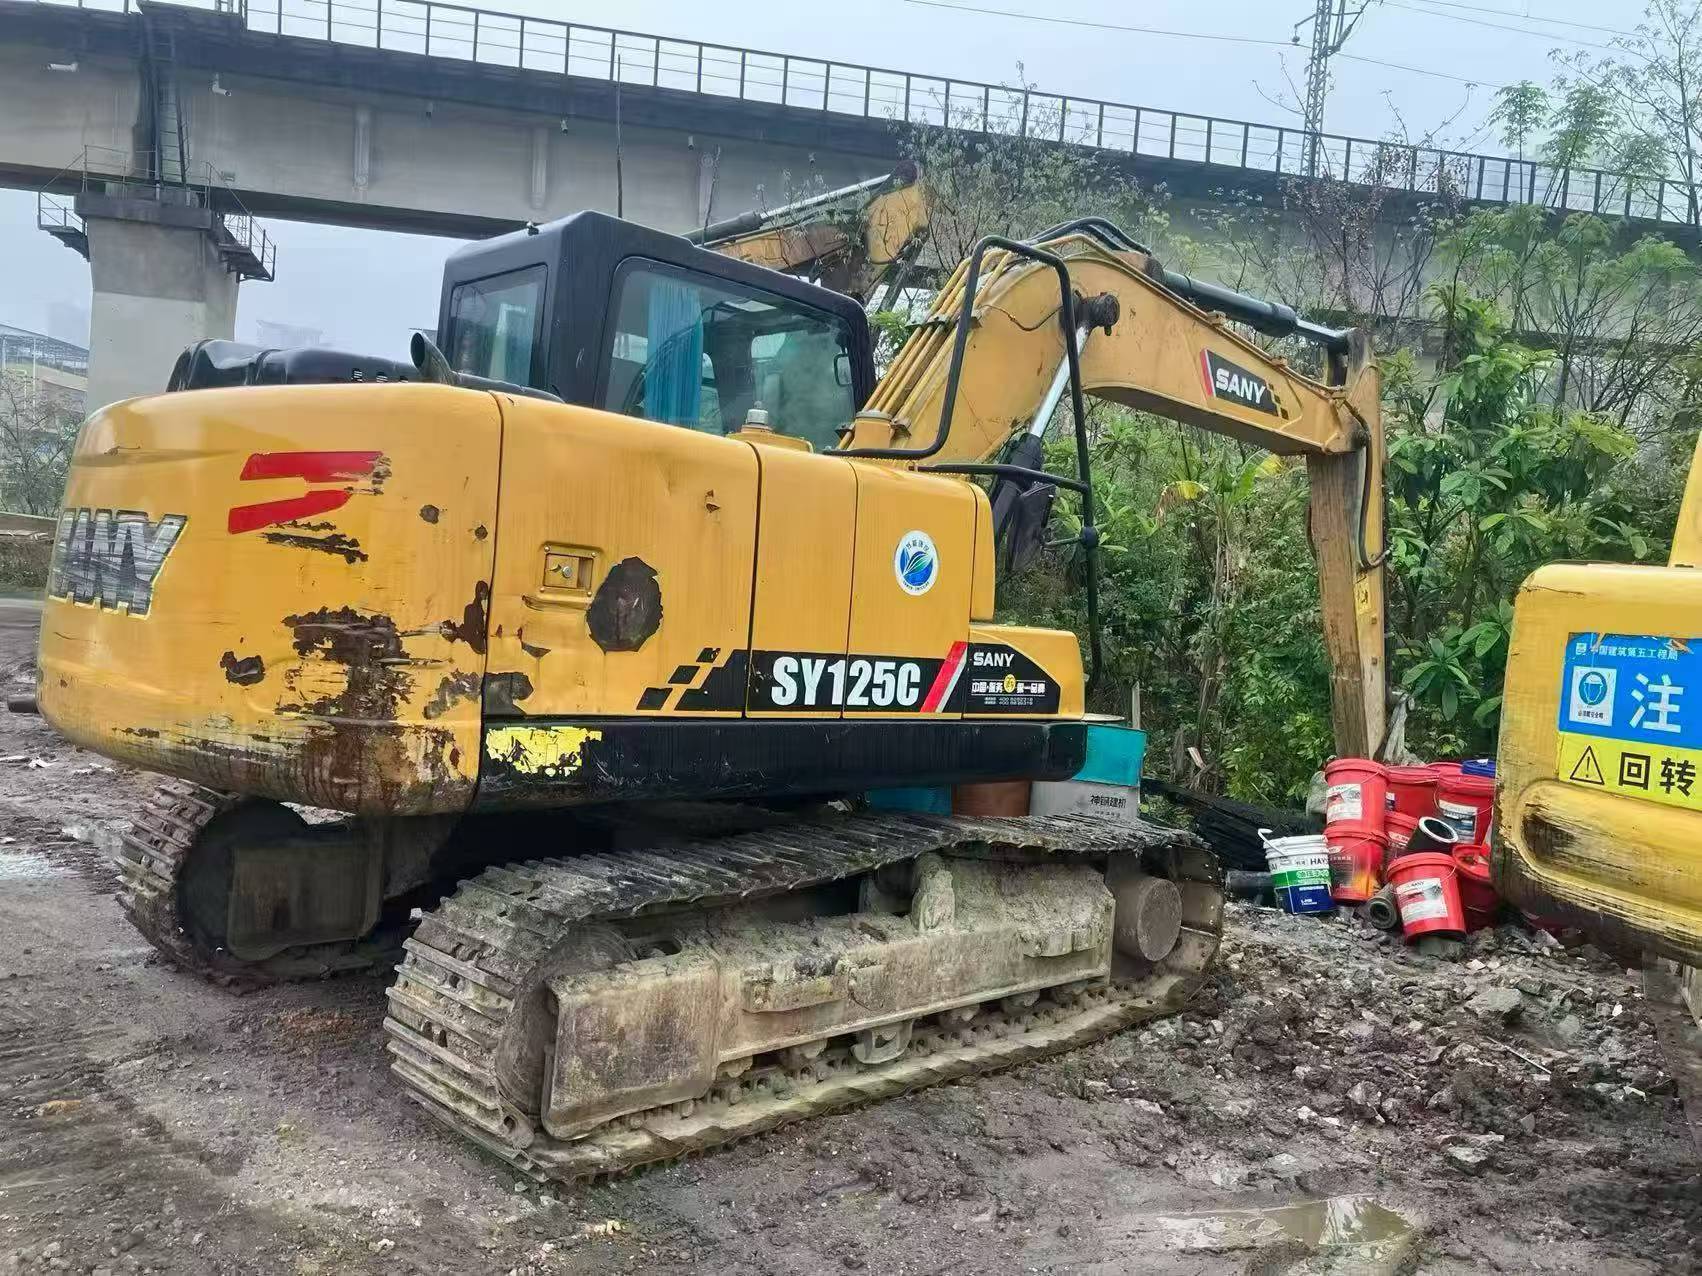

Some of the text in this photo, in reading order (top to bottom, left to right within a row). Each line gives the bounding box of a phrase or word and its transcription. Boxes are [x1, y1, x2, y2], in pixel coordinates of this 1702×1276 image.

[1215, 367, 1266, 405] SANY
[770, 656, 921, 707] SY125C
[973, 651, 1015, 667] SANY
[1629, 671, 1685, 734] 注
[1618, 751, 1697, 798] 回转
